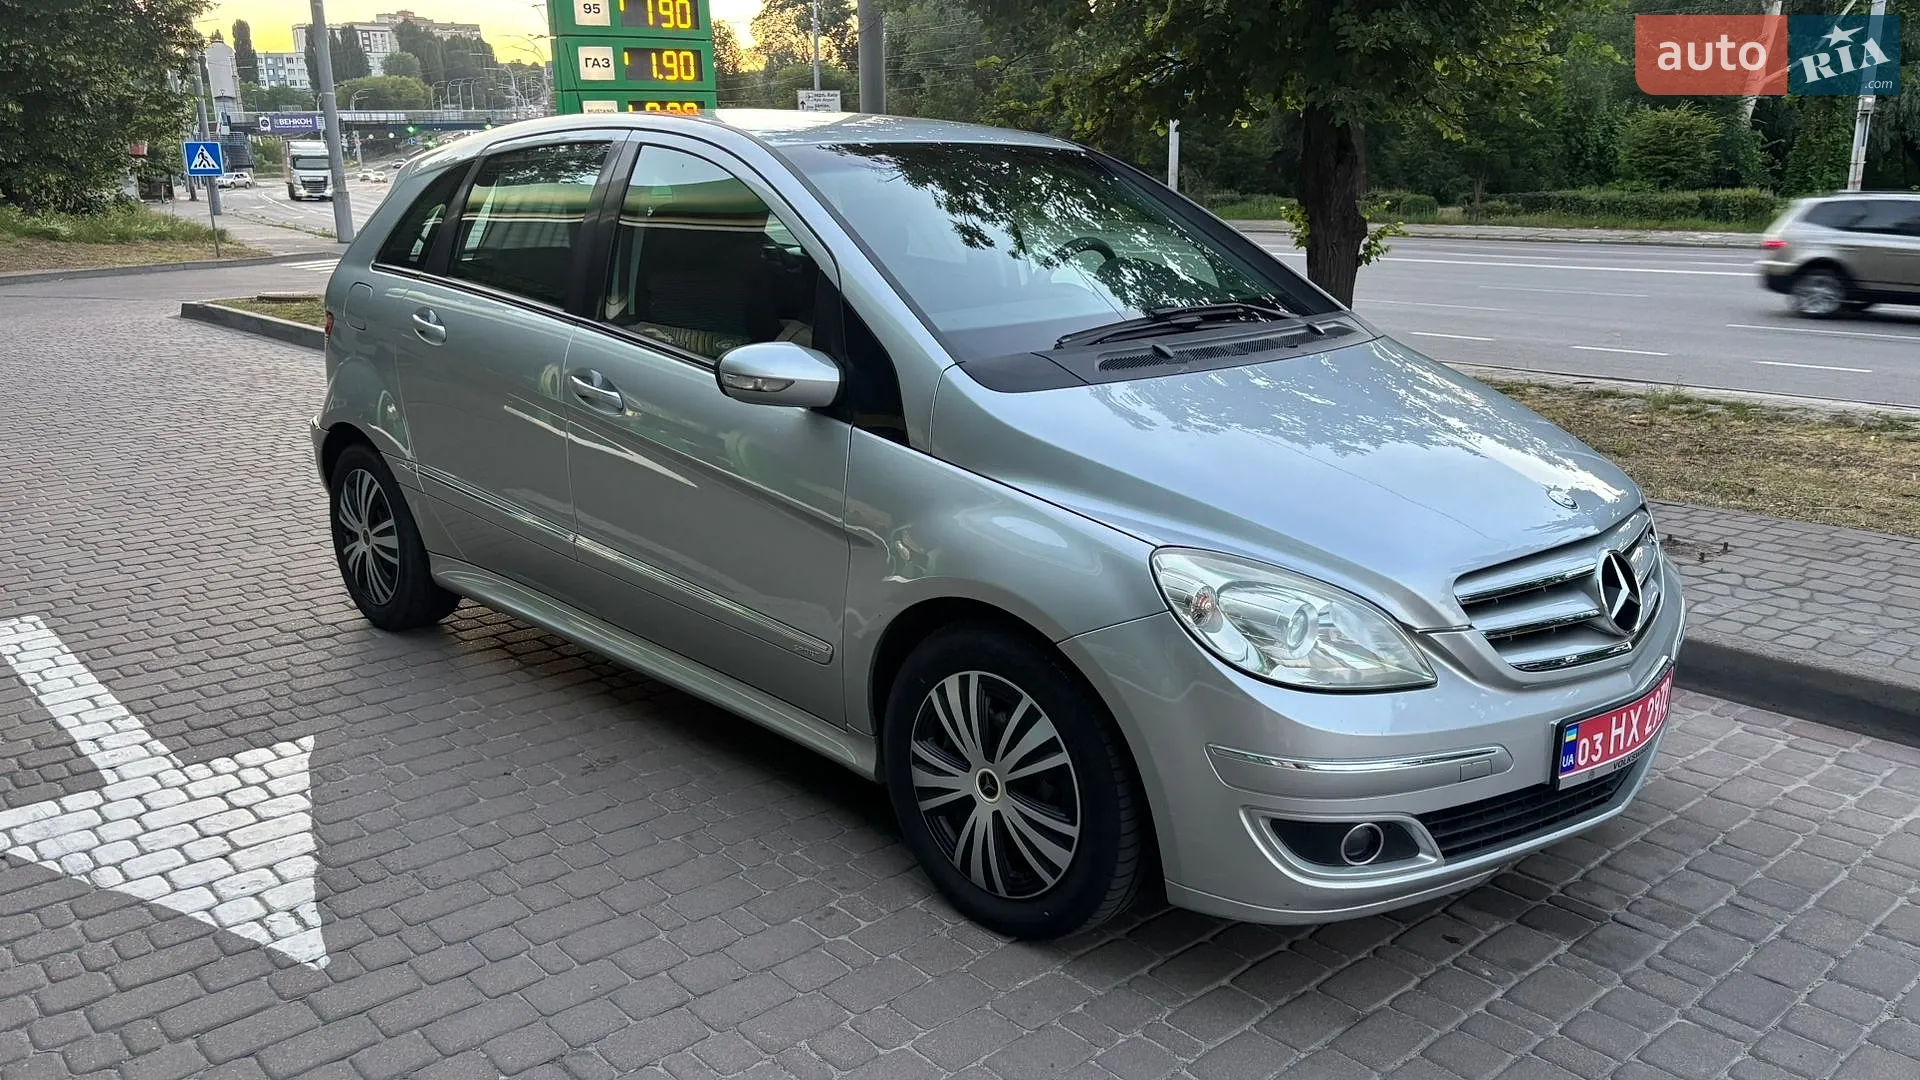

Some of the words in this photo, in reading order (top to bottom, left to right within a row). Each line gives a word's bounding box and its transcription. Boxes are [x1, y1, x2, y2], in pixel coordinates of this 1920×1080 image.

[583, 4, 600, 14] 95
[585, 57, 611, 68] ГАЗ
[1577, 732, 1604, 766] 03
[1609, 704, 1643, 755] HX
[1562, 754, 1574, 767] UA
